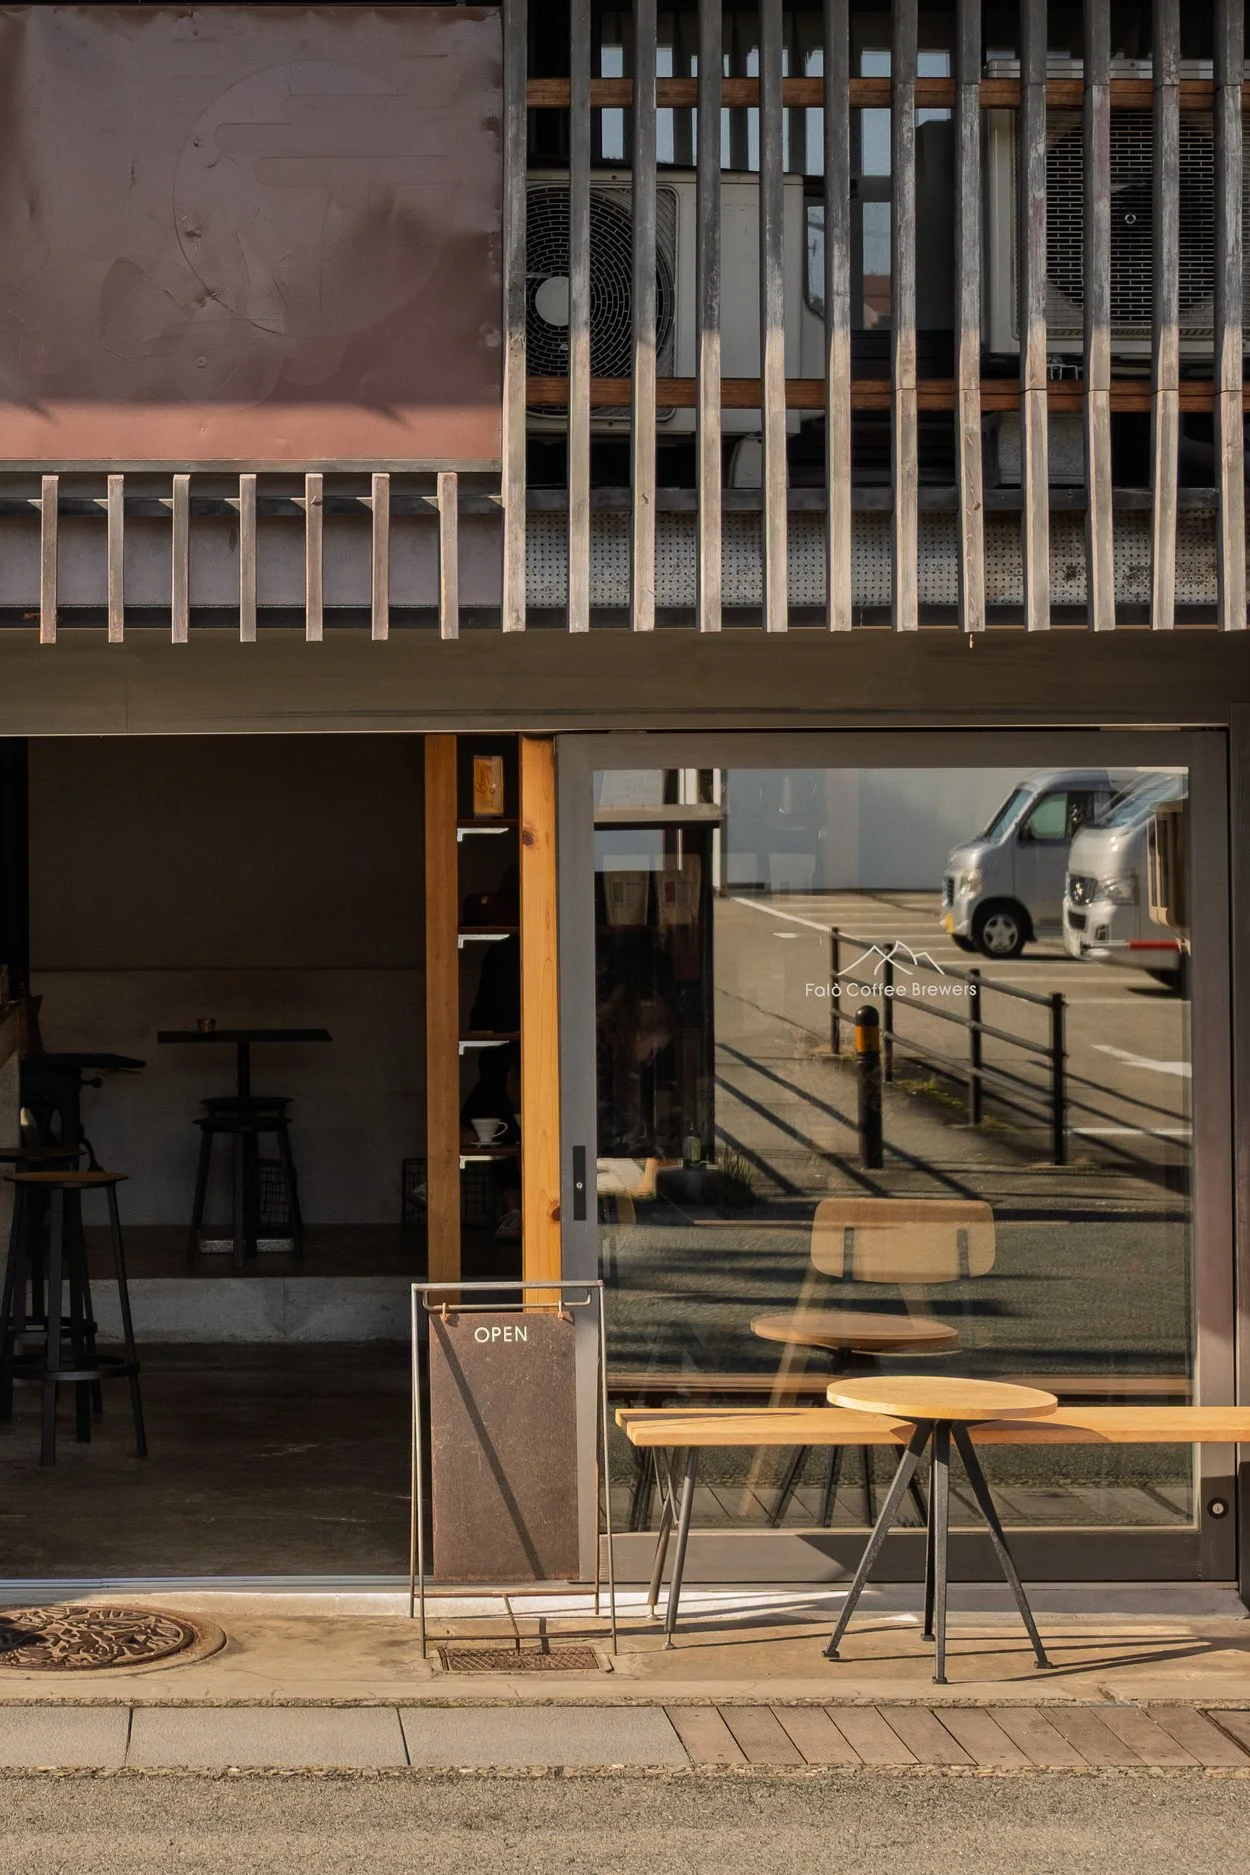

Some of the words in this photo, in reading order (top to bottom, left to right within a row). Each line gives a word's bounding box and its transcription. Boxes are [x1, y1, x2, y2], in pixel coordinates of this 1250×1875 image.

[805, 982, 842, 998] Falò
[846, 982, 907, 998] Coffee
[912, 982, 977, 998] Brewers
[474, 1326, 527, 1343] OPEN
